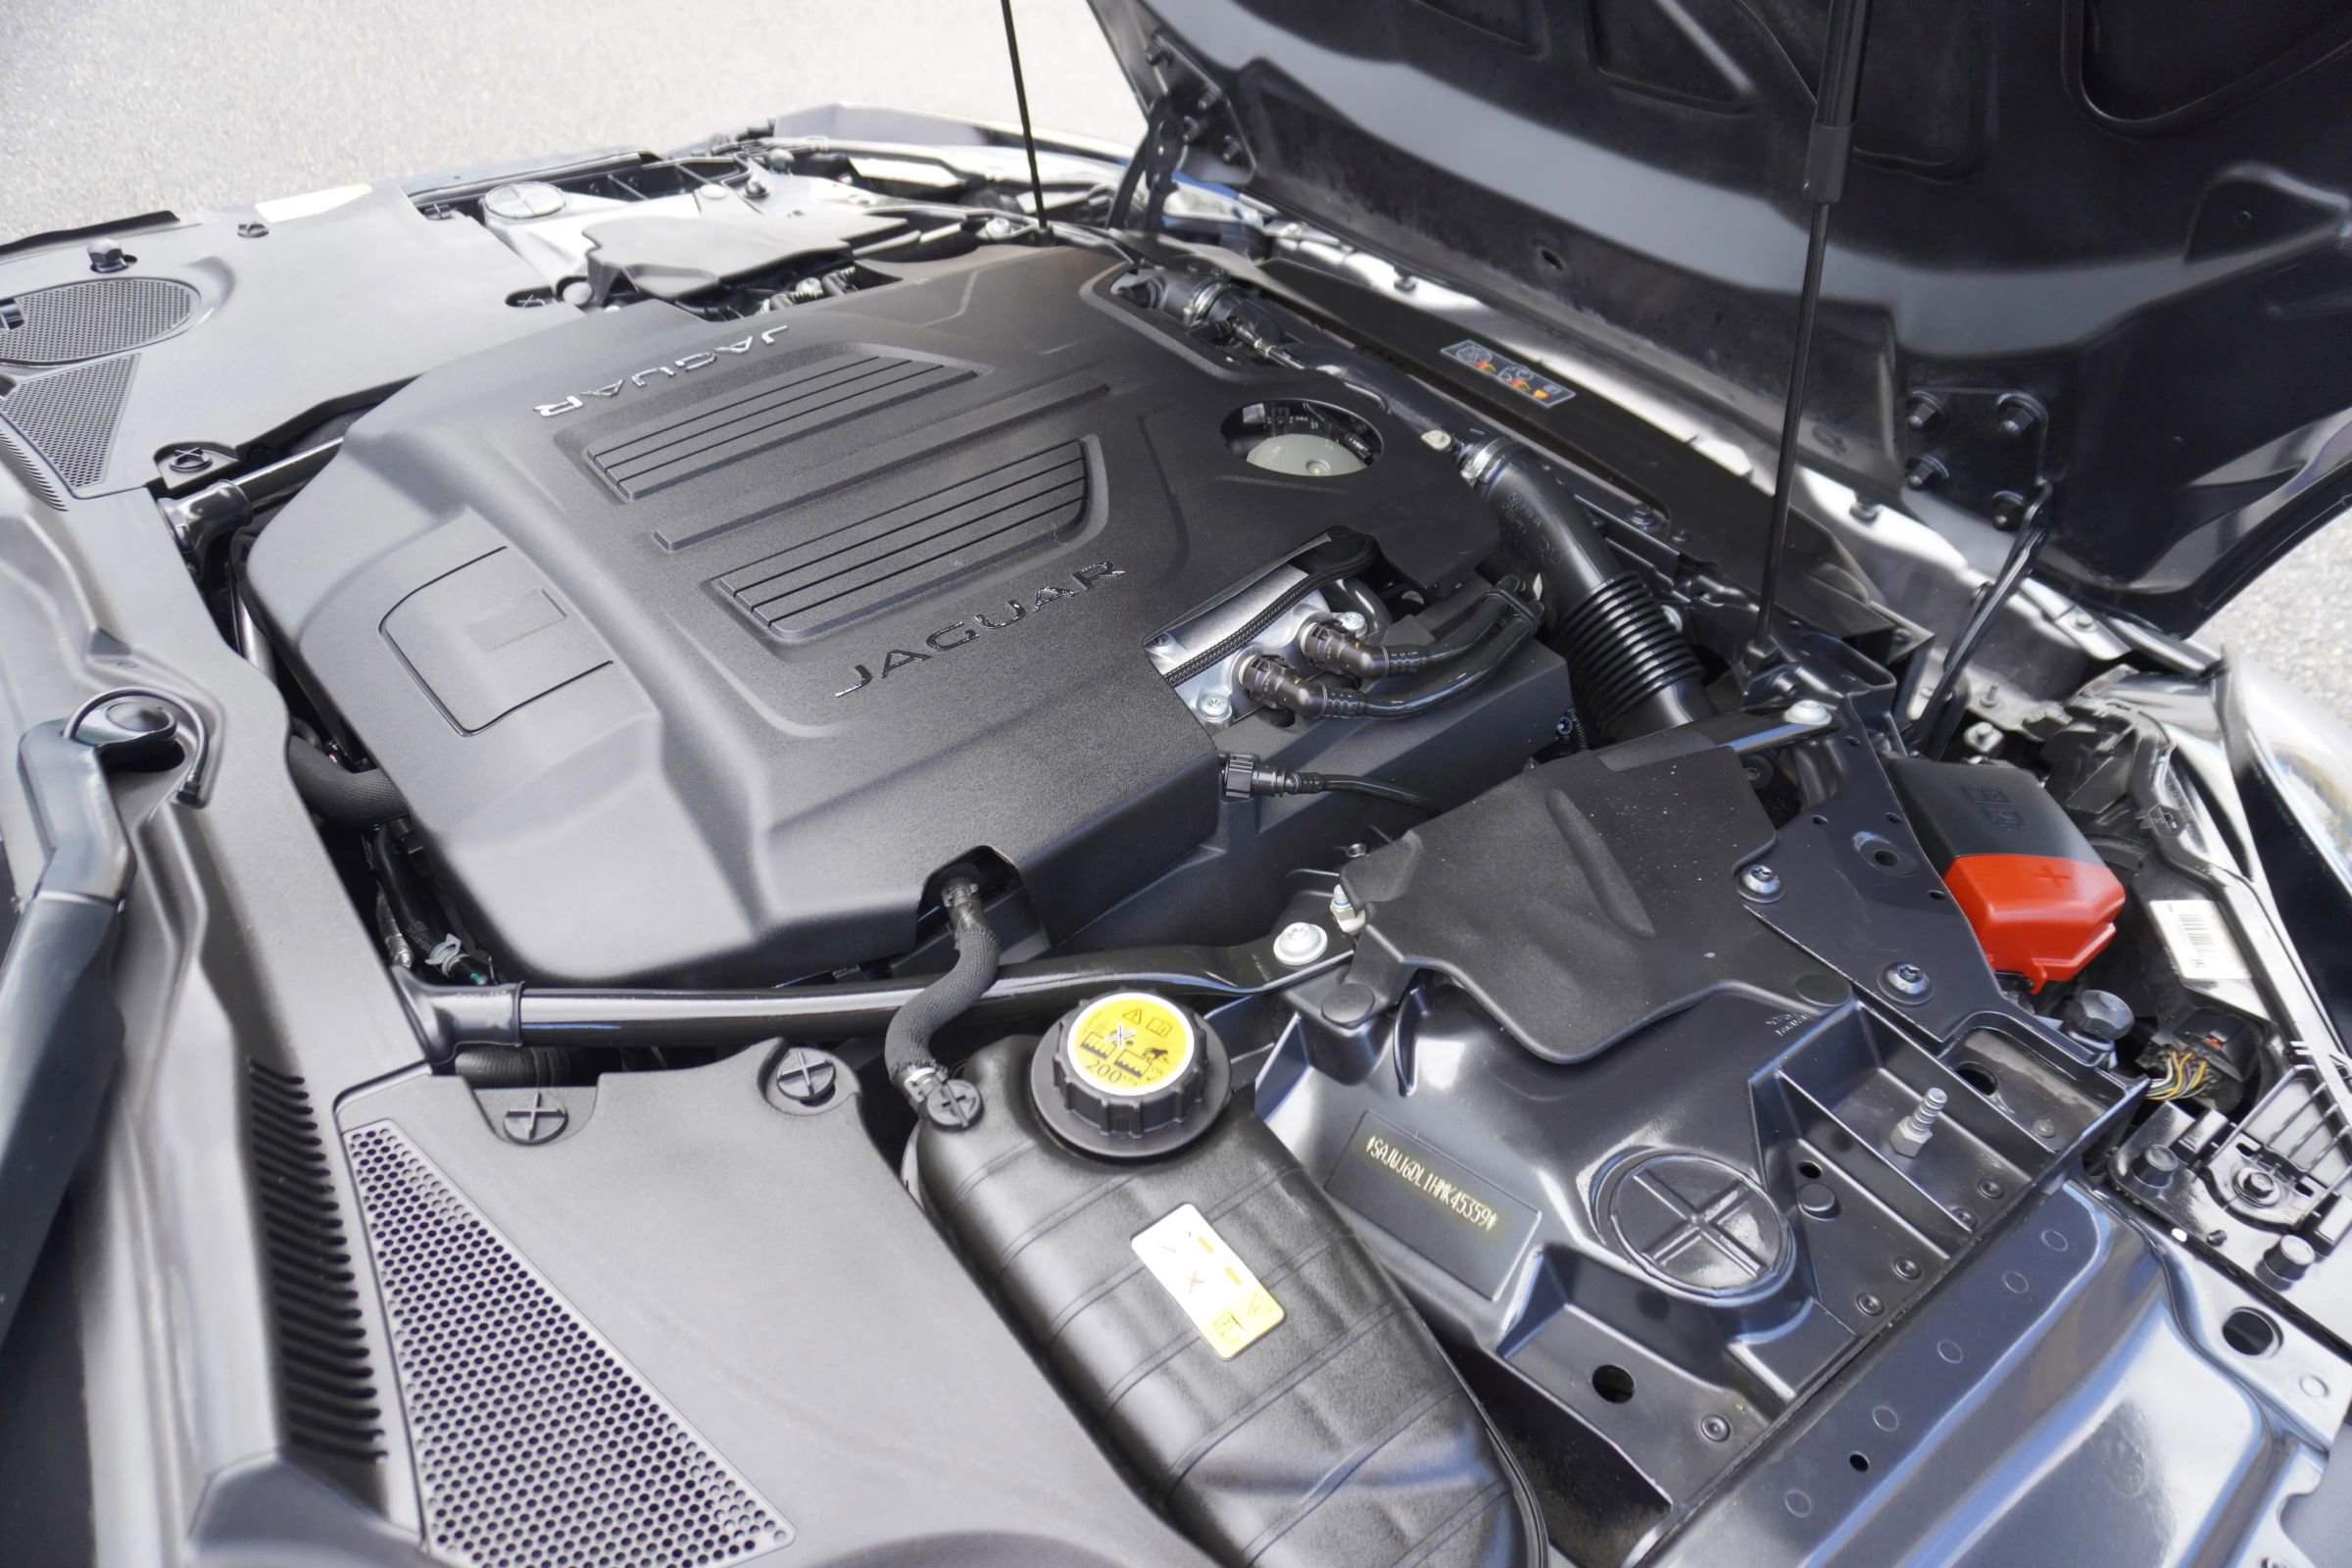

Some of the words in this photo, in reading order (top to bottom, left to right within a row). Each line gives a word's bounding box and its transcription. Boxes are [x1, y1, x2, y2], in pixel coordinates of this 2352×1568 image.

[533, 325, 788, 416] JAGUAR
[834, 560, 1125, 698] JAGUAR
[1087, 1059, 1122, 1083] 200
